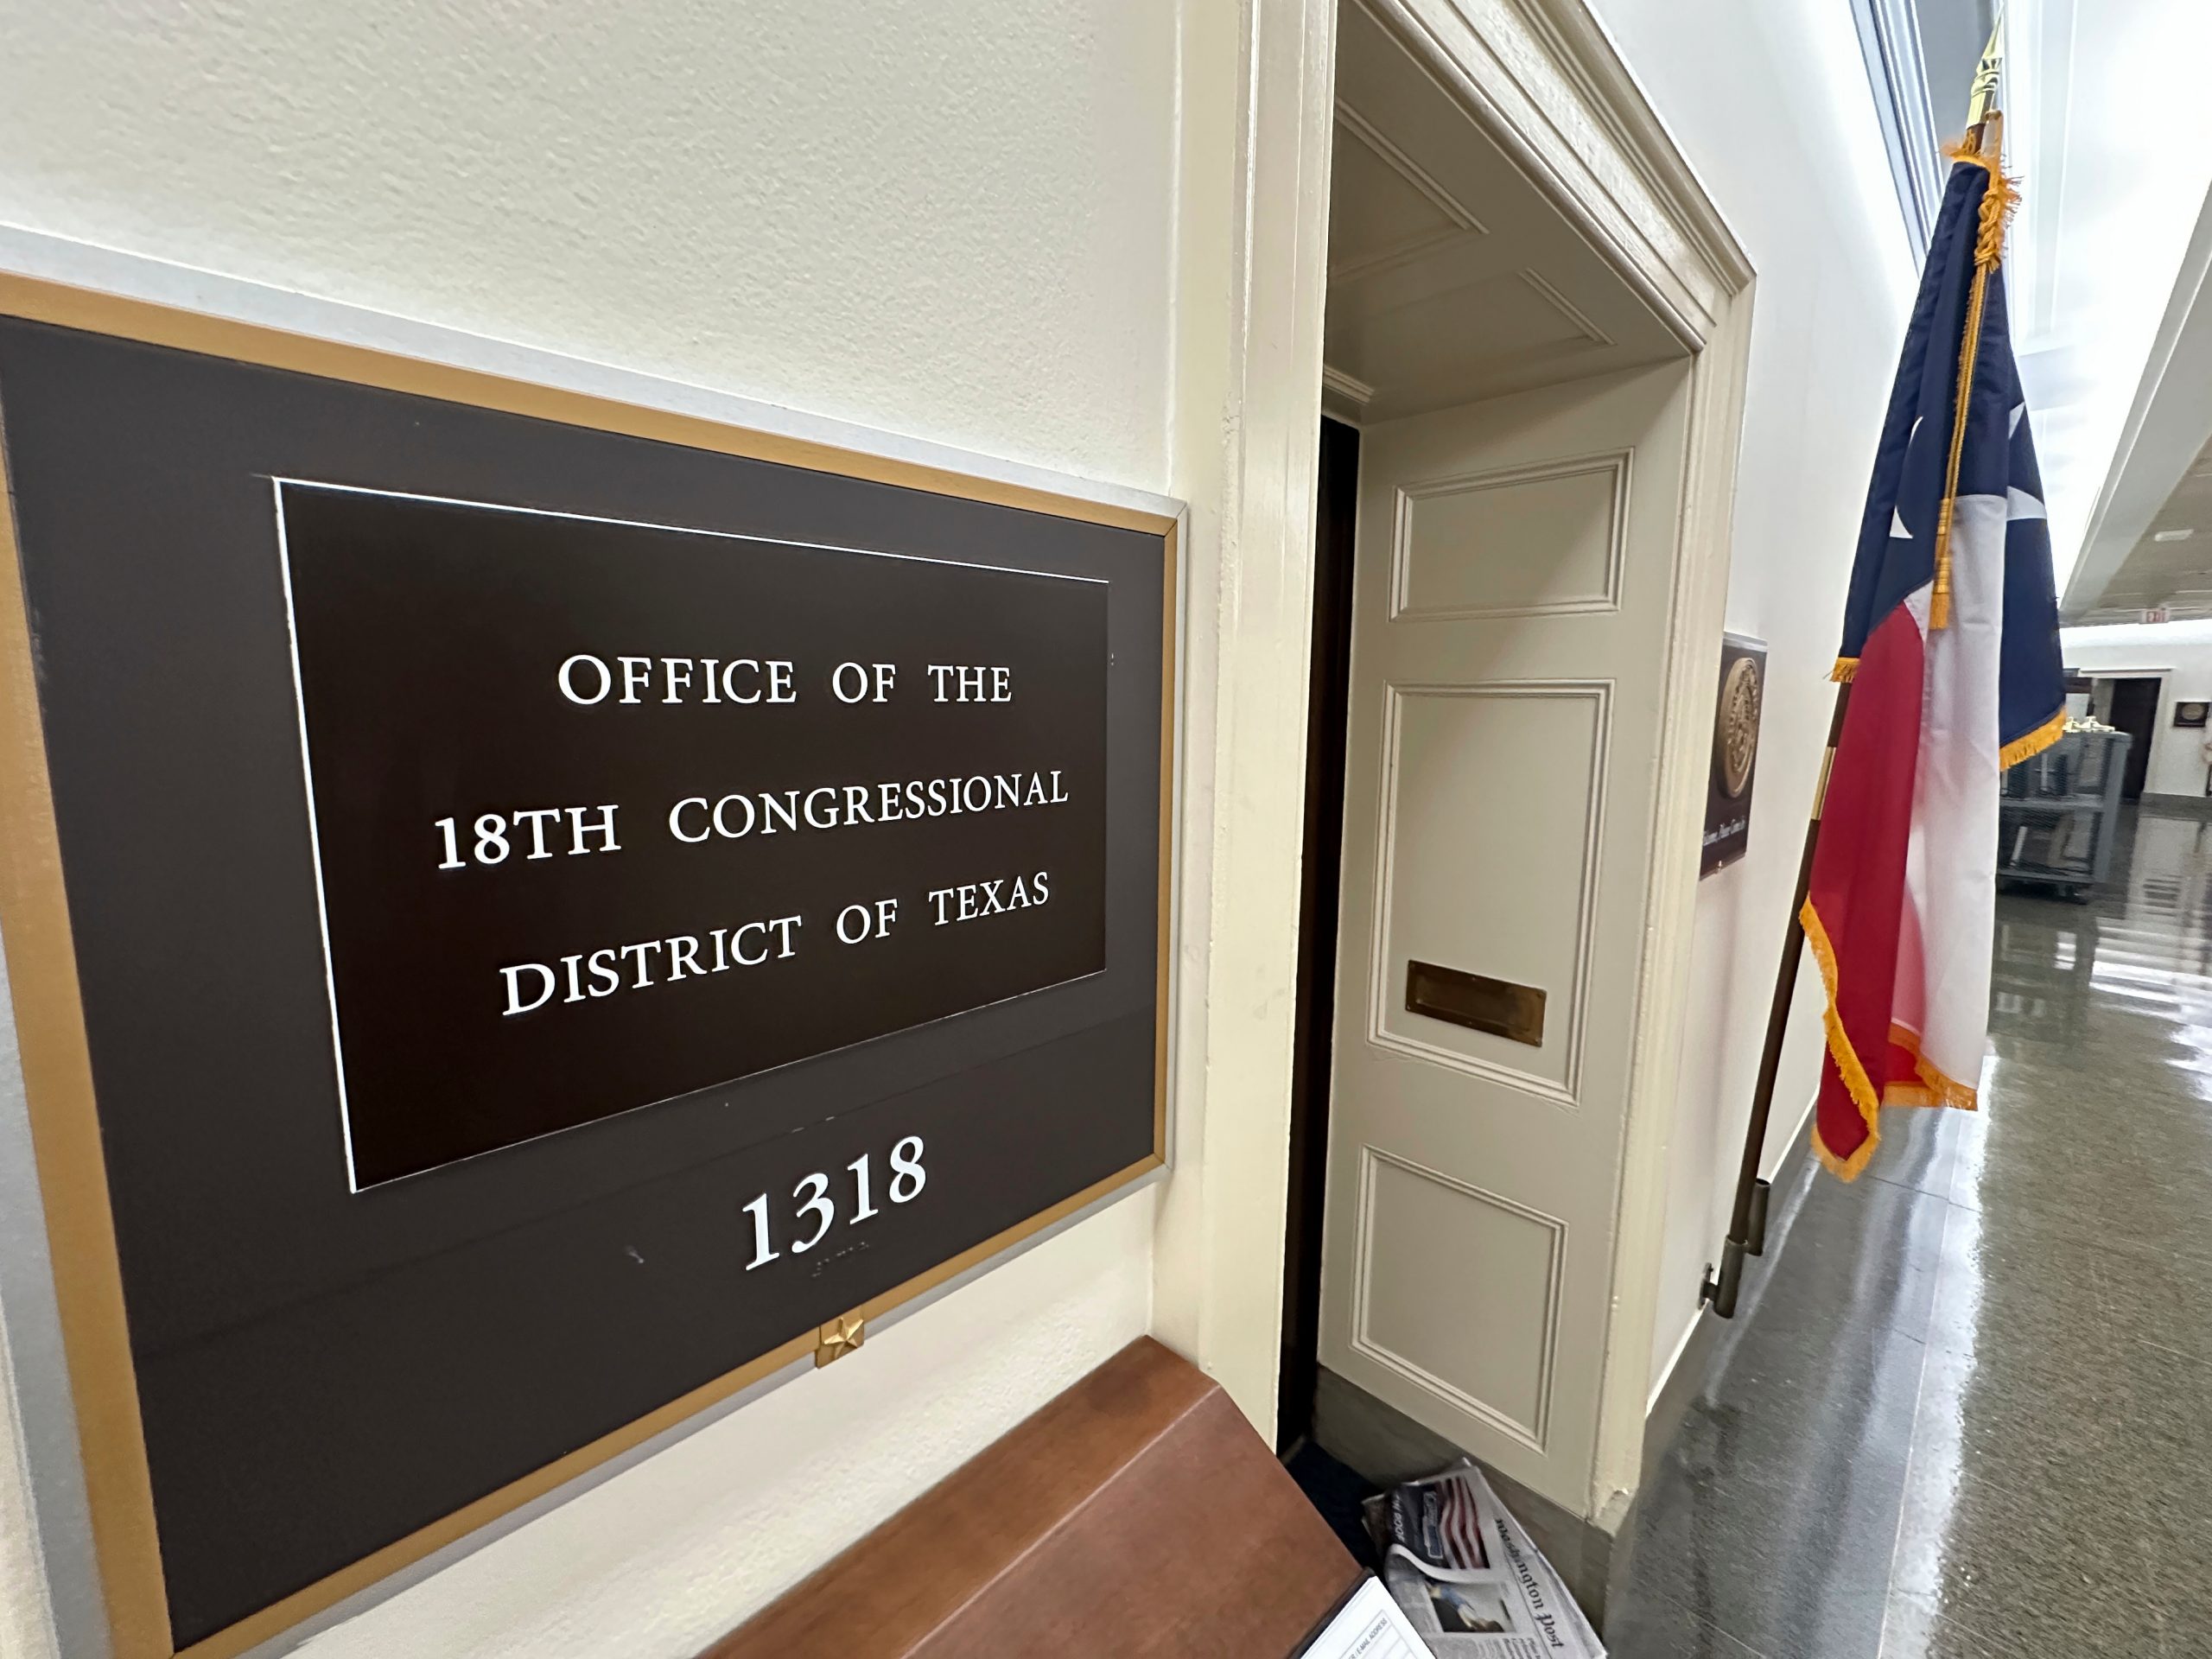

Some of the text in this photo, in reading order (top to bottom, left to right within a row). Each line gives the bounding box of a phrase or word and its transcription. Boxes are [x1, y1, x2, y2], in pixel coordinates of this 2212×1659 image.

[557, 654, 1013, 705] OFFICE OF THE
[435, 770, 1070, 869] 18TH CONGRESSIONAL
[499, 871, 1050, 1016] DISTRICT OF TEXAS
[741, 1135, 927, 1271] 1318
[1535, 1612, 1565, 1648] Post
